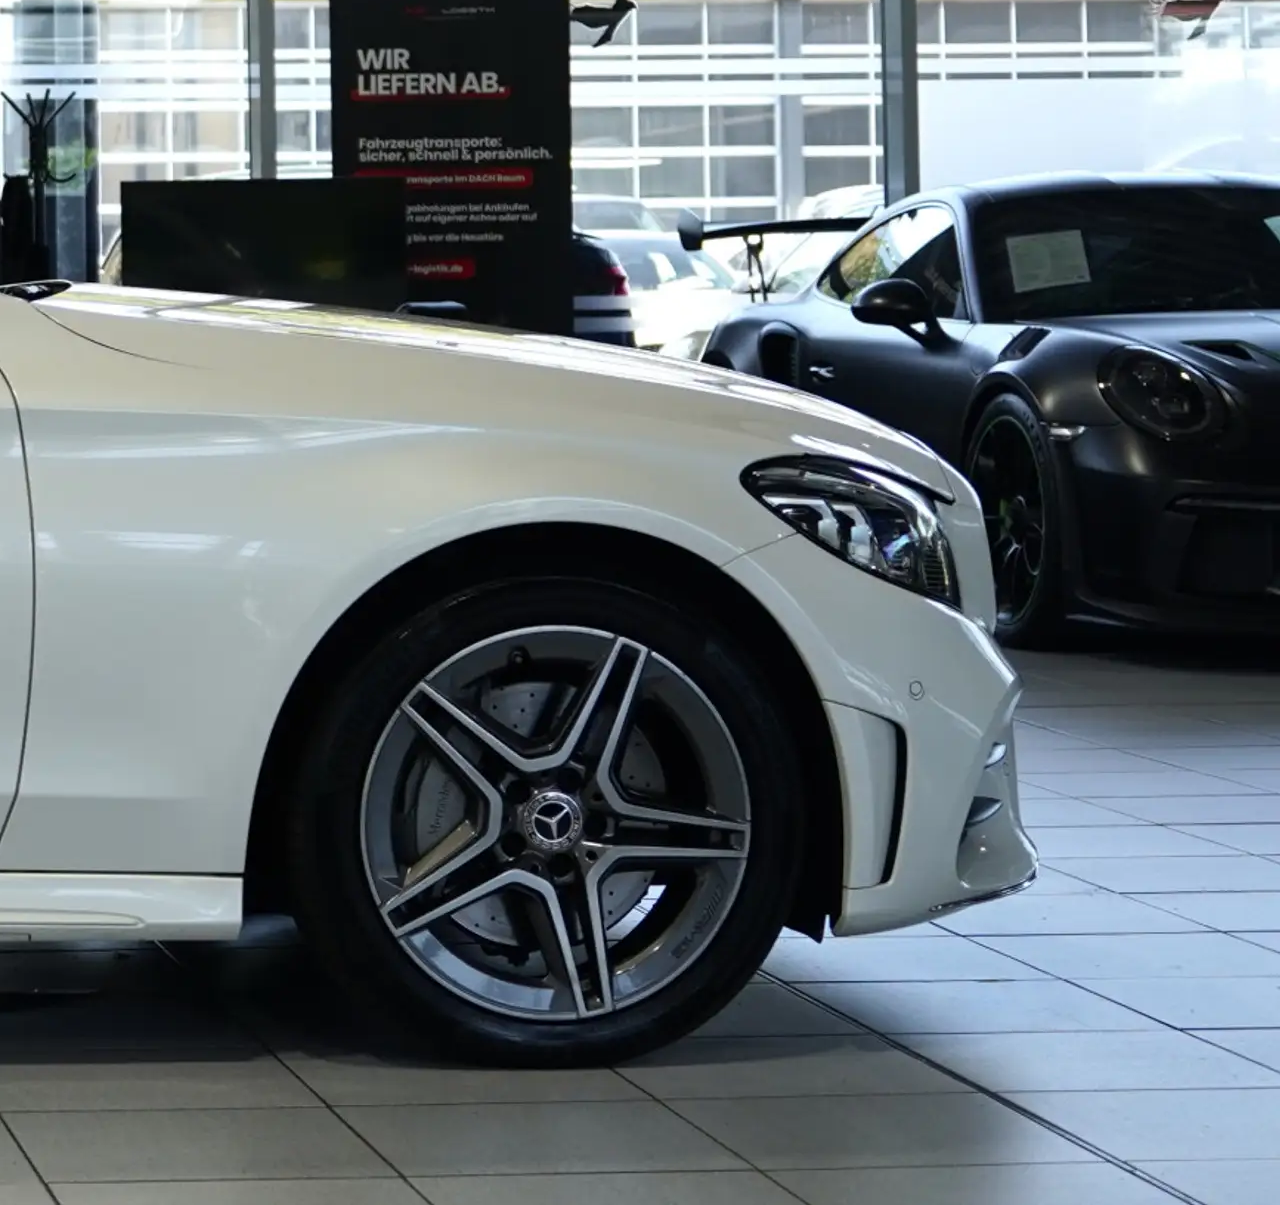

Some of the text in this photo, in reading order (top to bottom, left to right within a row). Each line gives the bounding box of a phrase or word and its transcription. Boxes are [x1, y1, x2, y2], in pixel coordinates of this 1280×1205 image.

[356, 47, 411, 71] WIR
[357, 70, 506, 97] LIEFERN AB.
[358, 137, 503, 151] Fahrzeugtransporte:
[358, 146, 554, 163] sicher, schnell & persönlich.
[406, 175, 454, 186] ransporte
